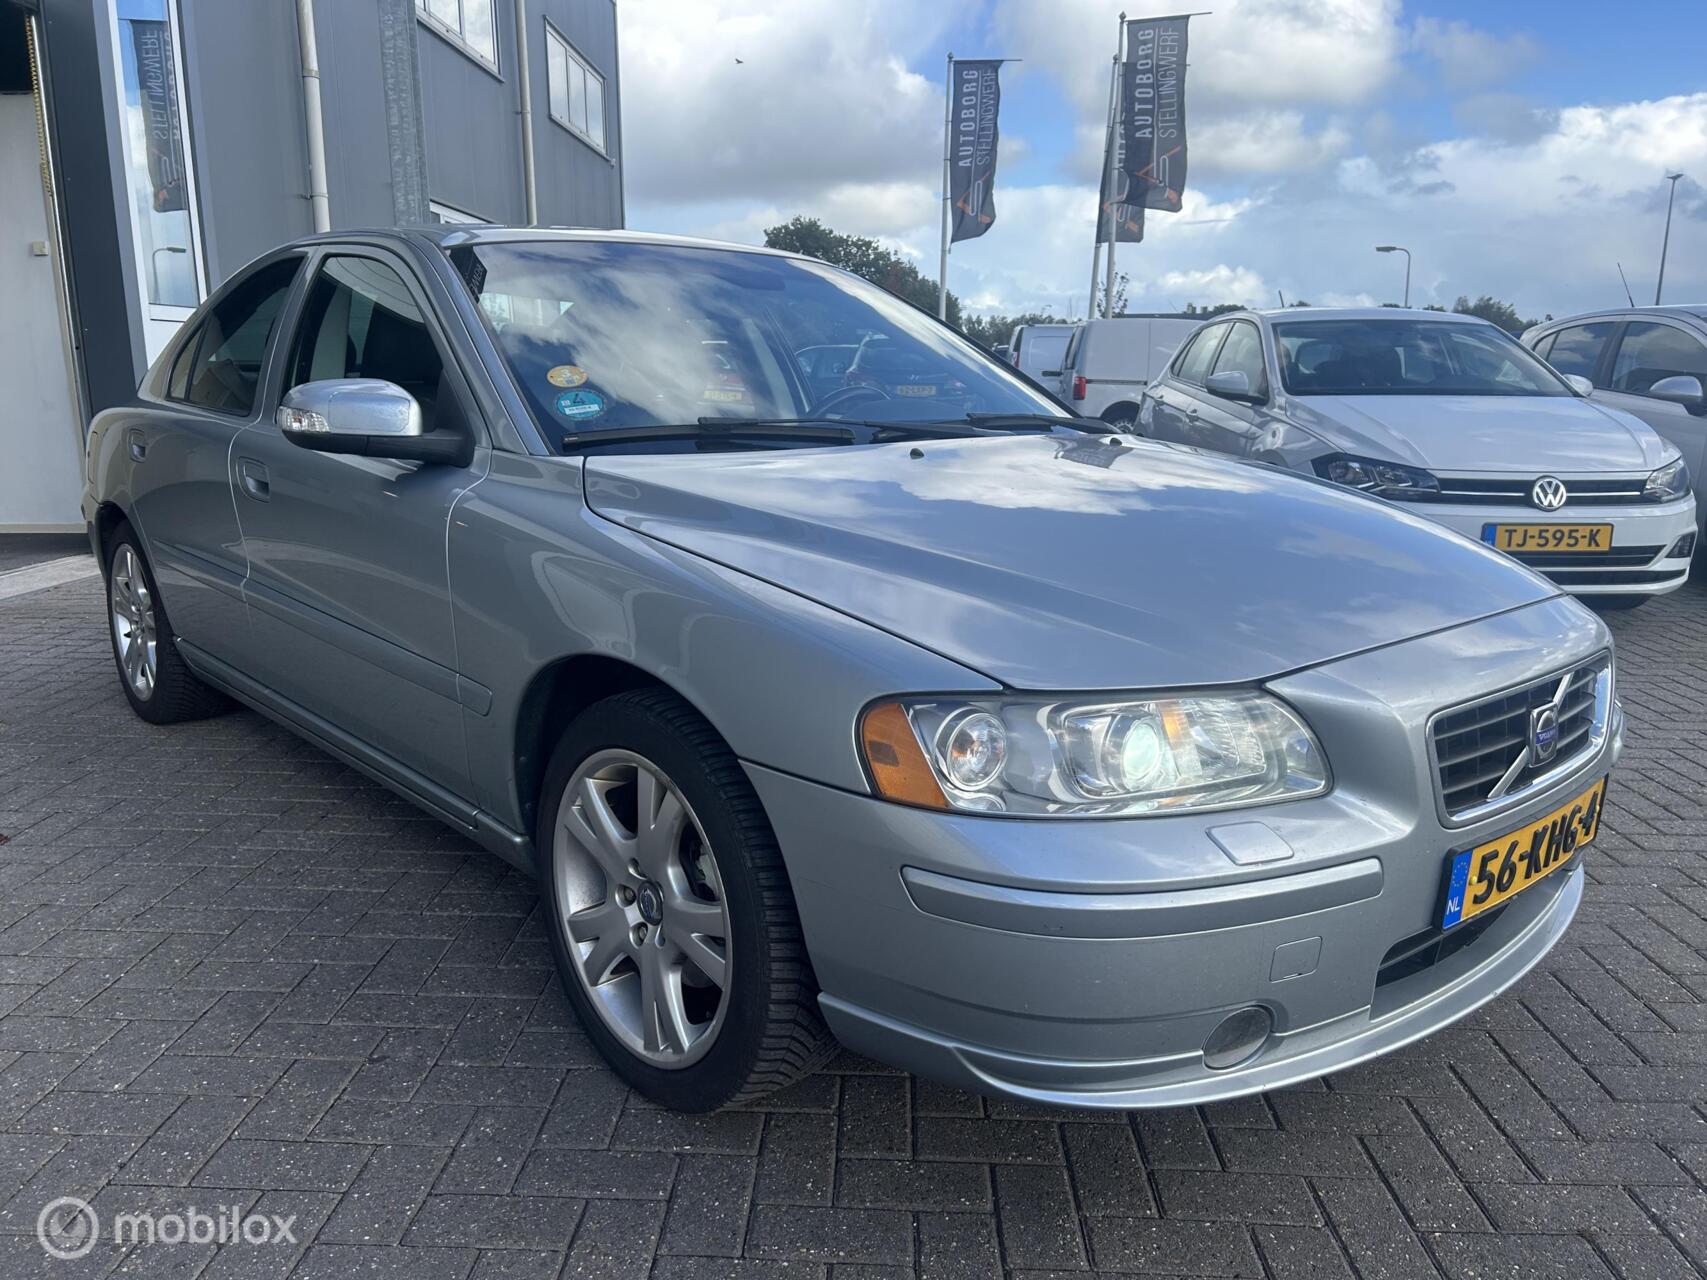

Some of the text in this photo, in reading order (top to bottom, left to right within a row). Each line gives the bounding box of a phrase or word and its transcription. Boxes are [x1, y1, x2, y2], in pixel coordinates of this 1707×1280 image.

[958, 70, 978, 167] AUTOBORG
[976, 68, 997, 166] STELLINGWERF
[1134, 29, 1154, 138] AUTOBORG
[1158, 27, 1179, 138] STELLINGWERF
[1504, 528, 1601, 548] TJ-595-K
[1446, 895, 1461, 915] NL
